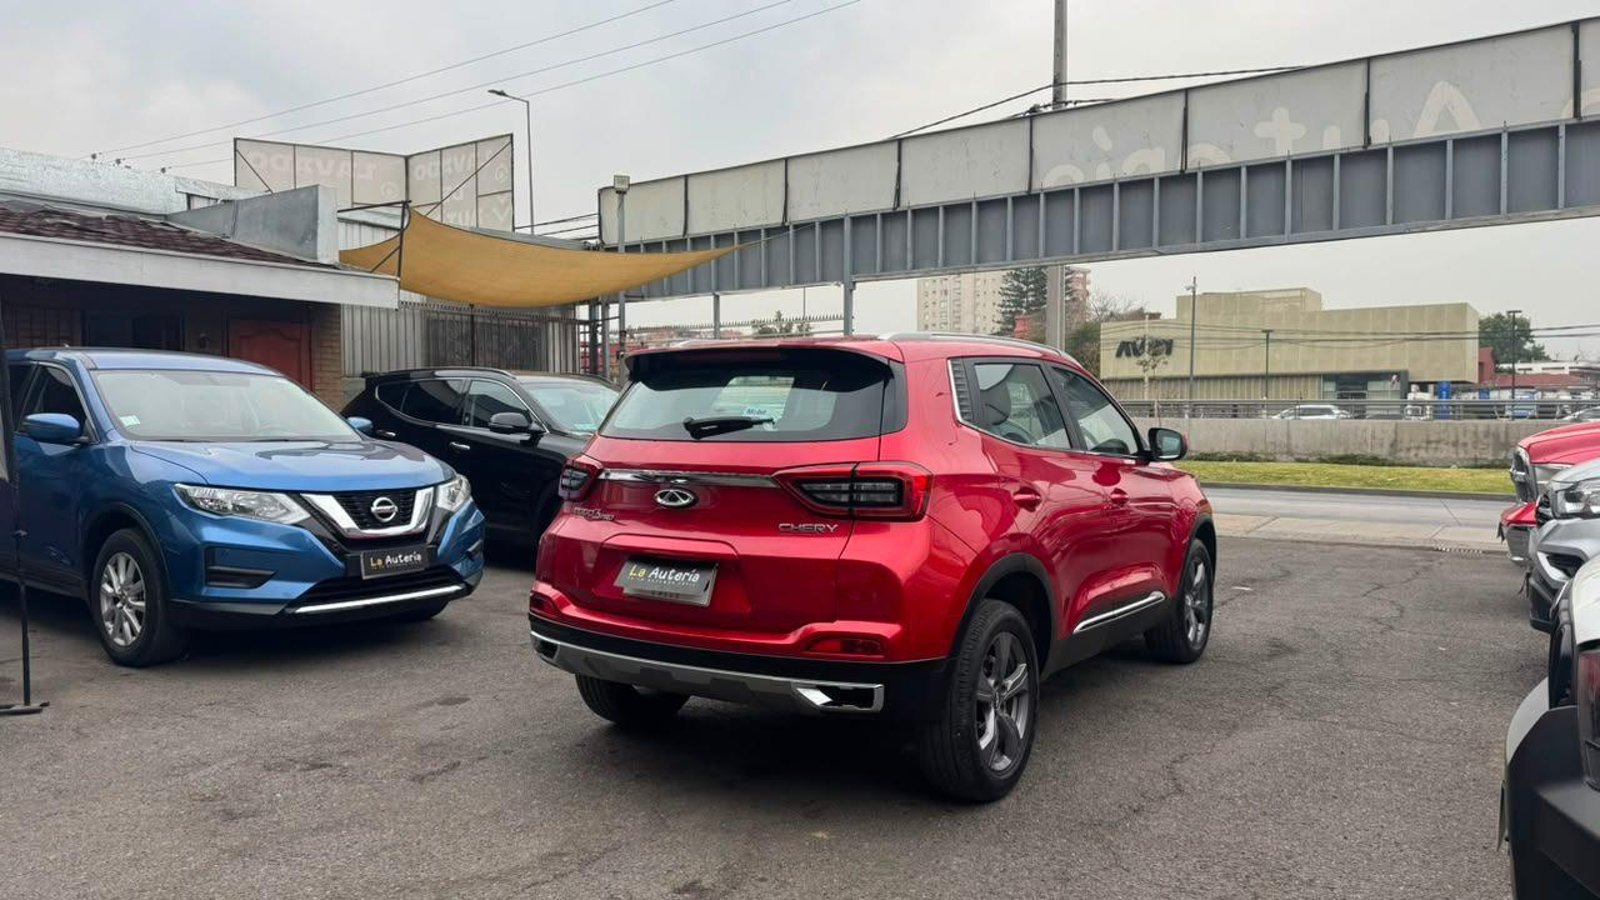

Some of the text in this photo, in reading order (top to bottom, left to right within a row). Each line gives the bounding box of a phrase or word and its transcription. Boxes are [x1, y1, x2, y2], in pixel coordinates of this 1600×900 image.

[778, 522, 839, 533] CHERY
[370, 556, 384, 567] La
[628, 564, 646, 578] La
